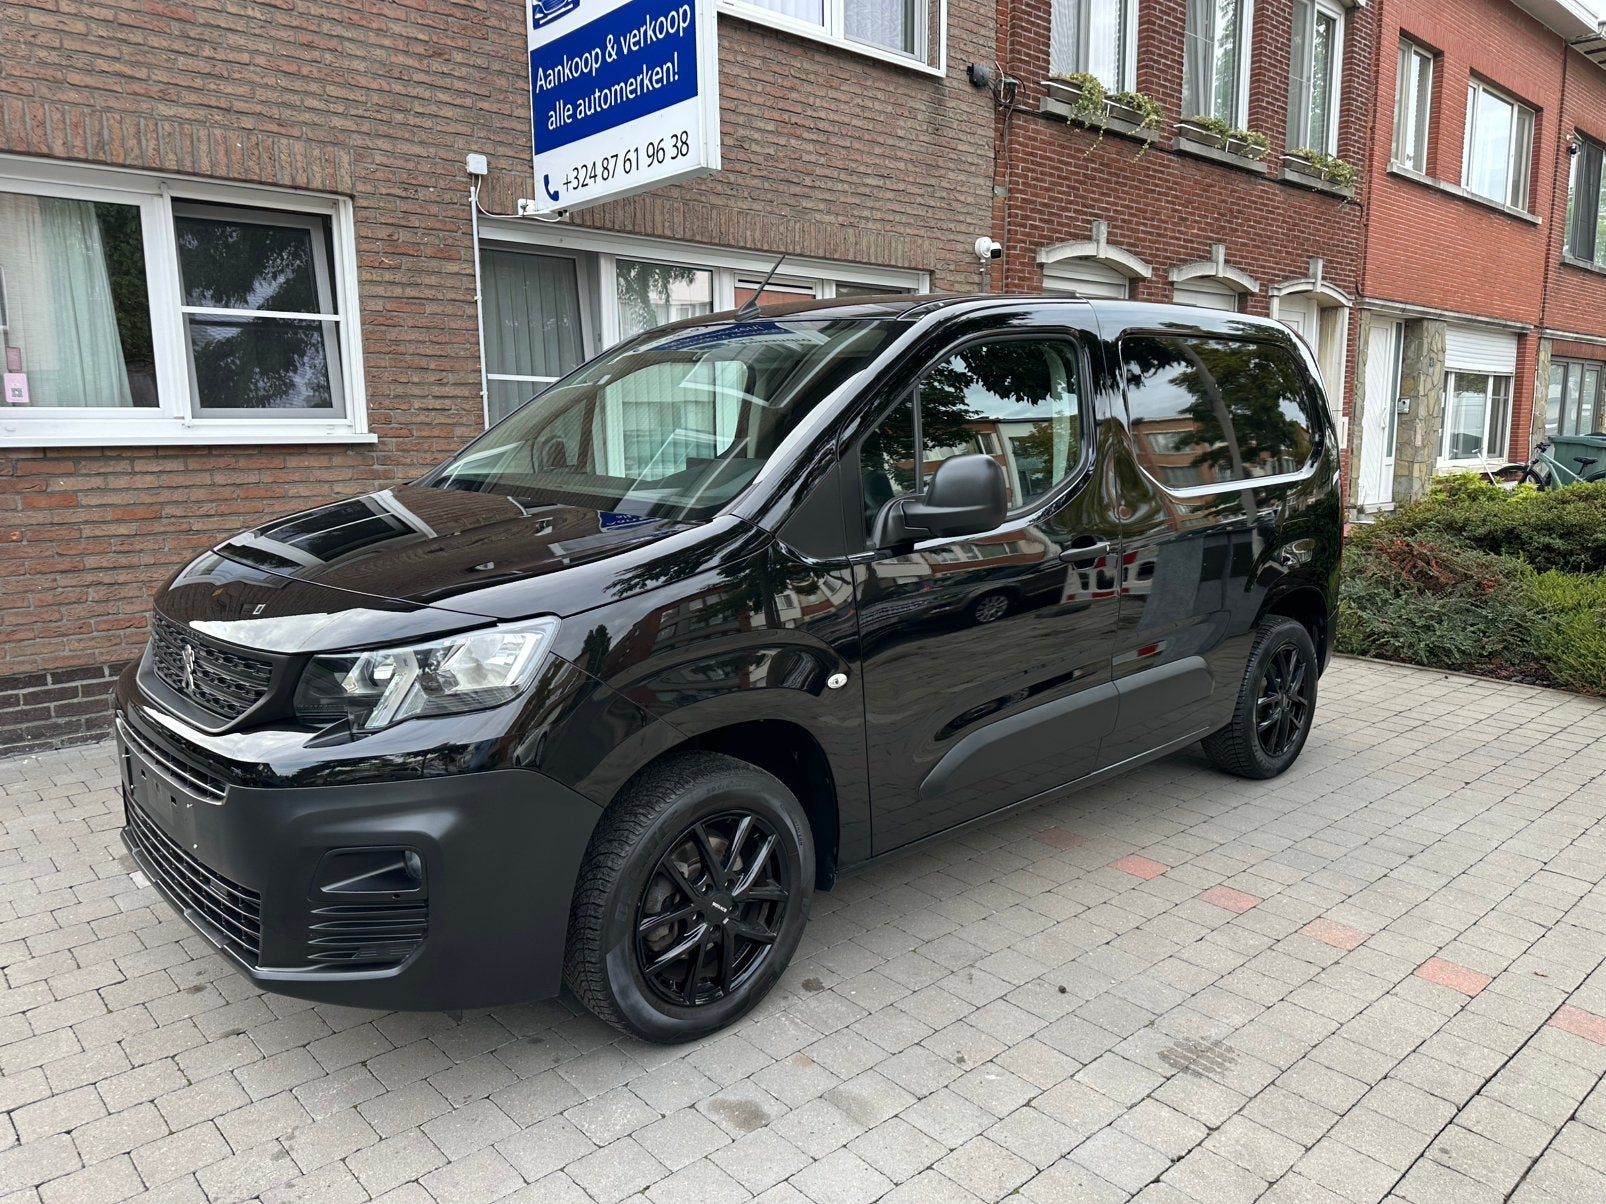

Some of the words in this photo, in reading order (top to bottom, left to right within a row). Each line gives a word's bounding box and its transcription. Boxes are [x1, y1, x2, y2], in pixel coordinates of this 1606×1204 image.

[536, 47, 602, 93] Aankoop
[605, 34, 618, 63] &
[620, 4, 691, 55] verkoop
[548, 99, 573, 130] alle
[576, 51, 679, 119] automerken!
[562, 161, 598, 192] +324
[601, 154, 619, 181] 87
[623, 147, 640, 174] 61
[646, 138, 666, 167] 96
[670, 130, 690, 160] 38
